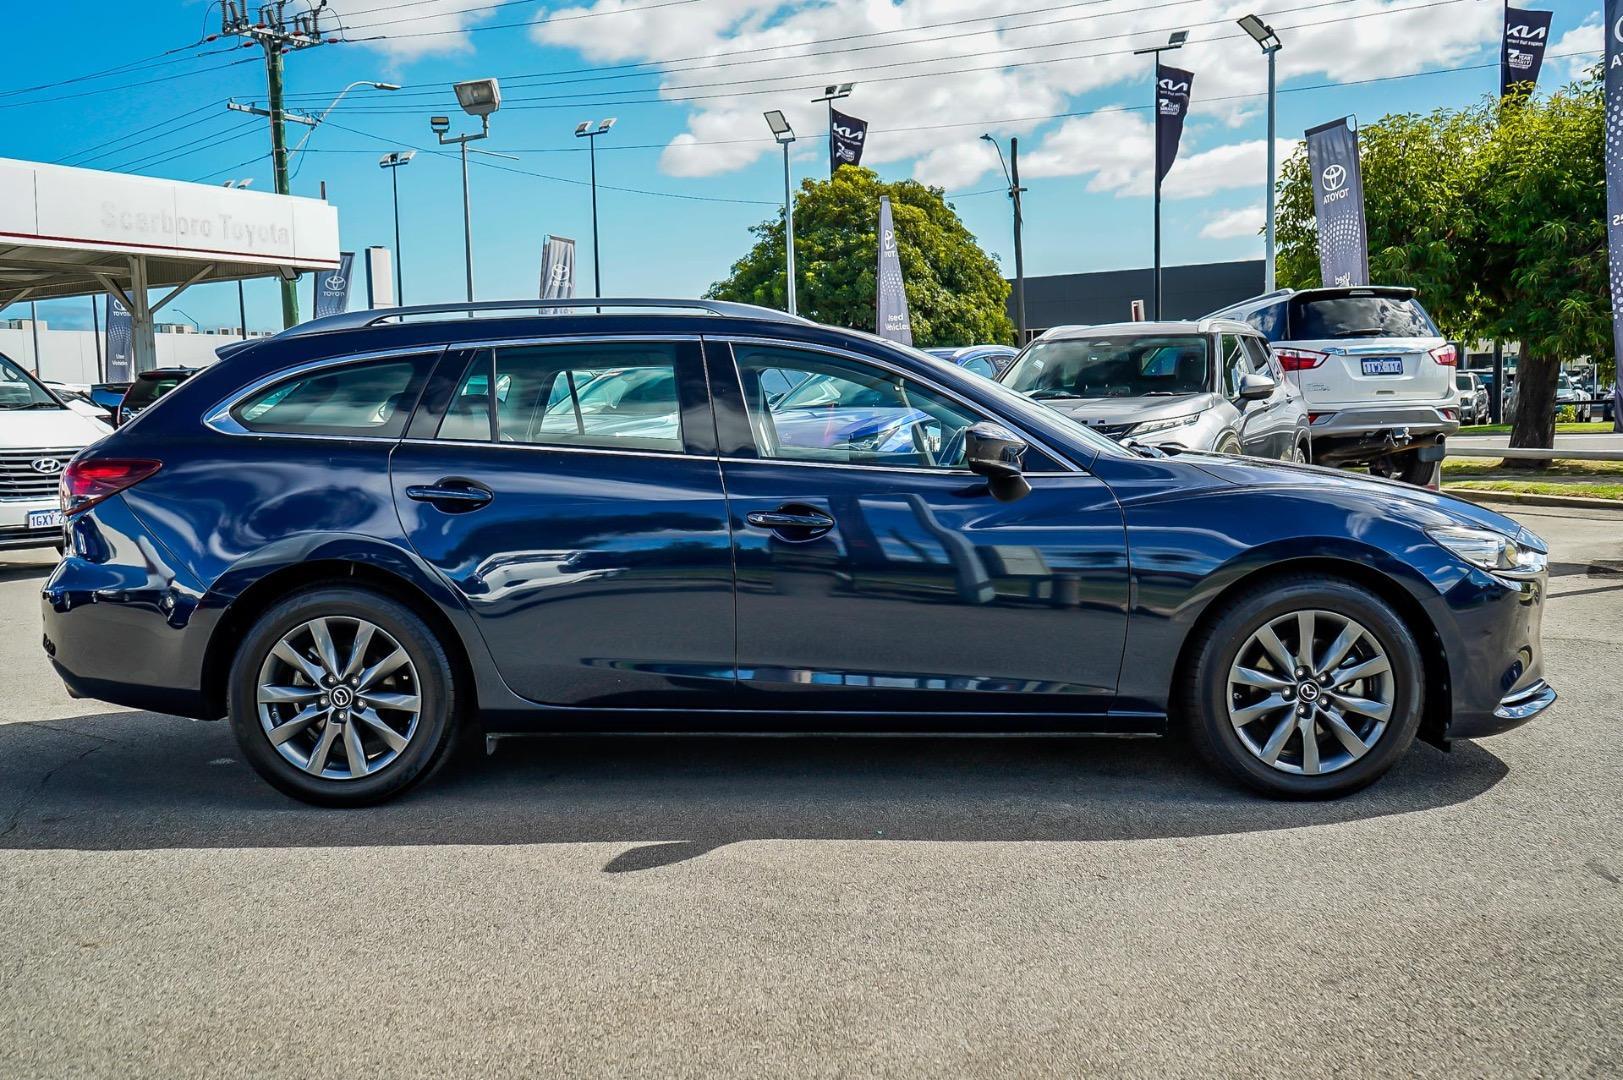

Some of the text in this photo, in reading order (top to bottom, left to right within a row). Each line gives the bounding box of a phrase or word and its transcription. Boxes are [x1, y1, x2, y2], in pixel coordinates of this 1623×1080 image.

[1507, 23, 1546, 39] KIA
[833, 122, 863, 140] KIA
[101, 200, 290, 247] Scarboro Toyota
